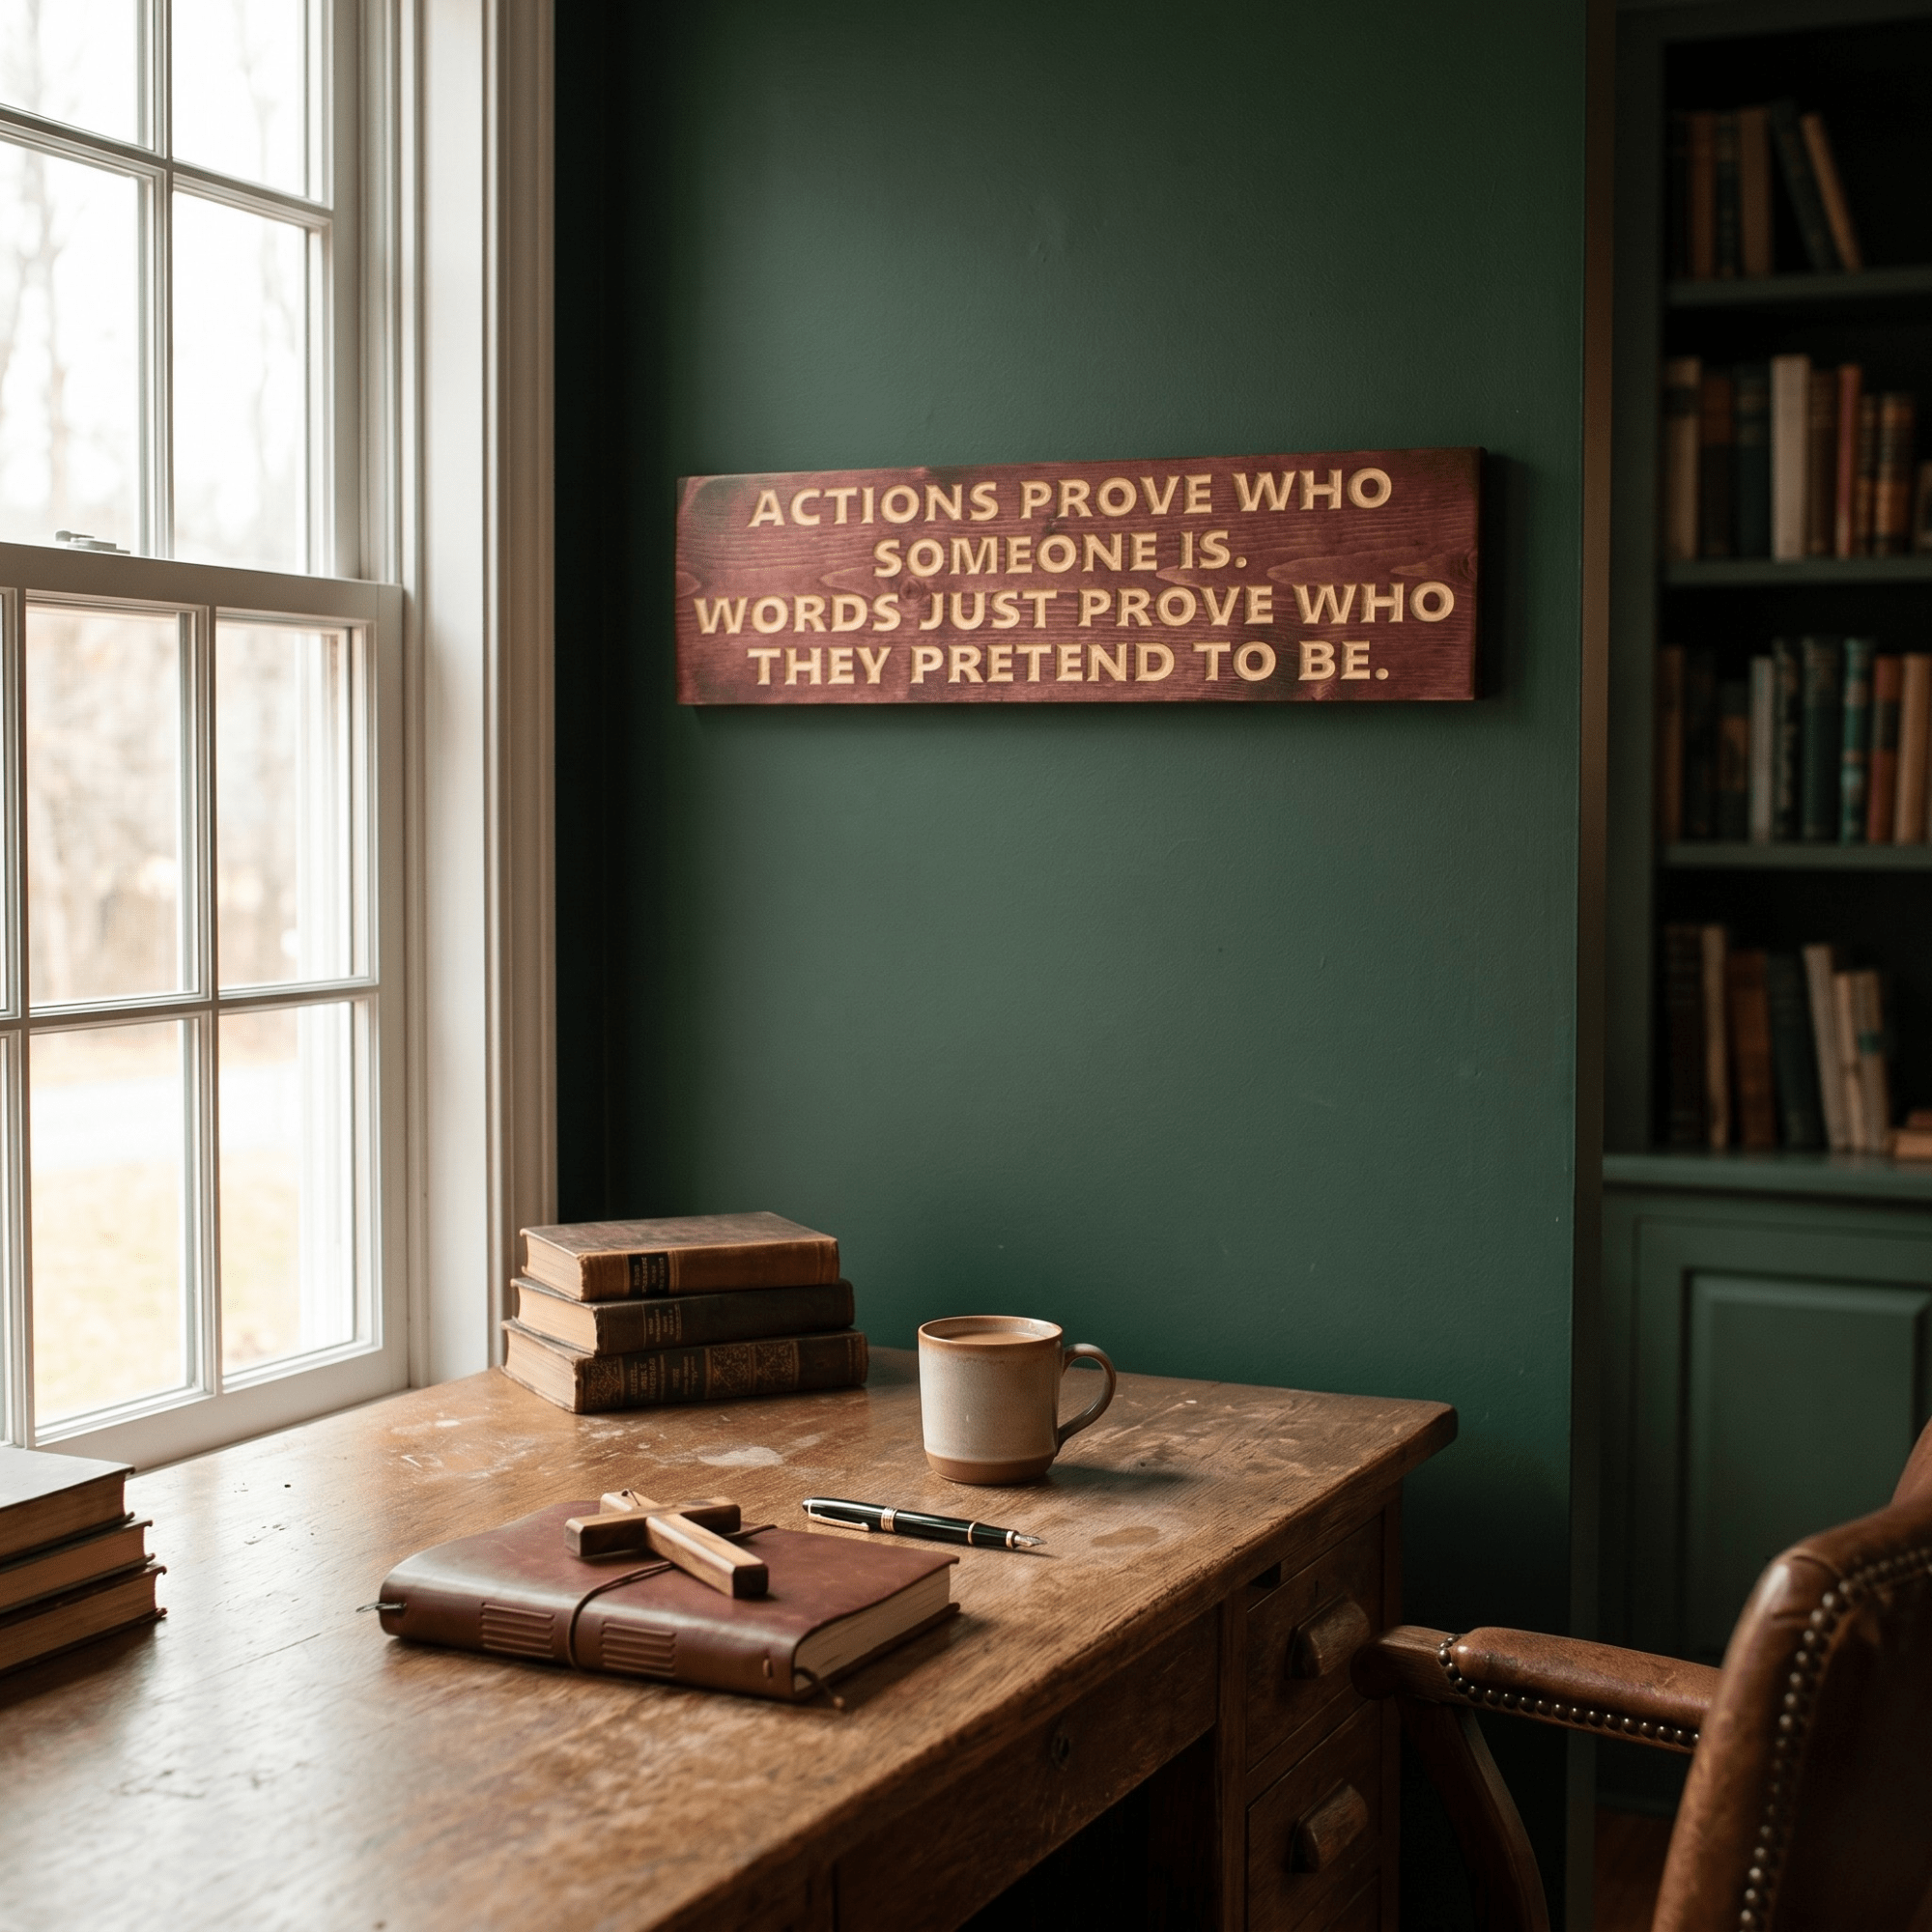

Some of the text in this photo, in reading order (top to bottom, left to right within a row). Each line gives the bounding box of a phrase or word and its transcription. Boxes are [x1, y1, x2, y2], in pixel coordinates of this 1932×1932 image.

[748, 468, 1393, 528] ACTIONS PROVE WHO
[873, 529, 1248, 578] SOMEONE IS.
[694, 581, 1456, 635] WORDS JUST PROVE WHO
[748, 639, 1390, 687] THEY PRETEND TO BE.
